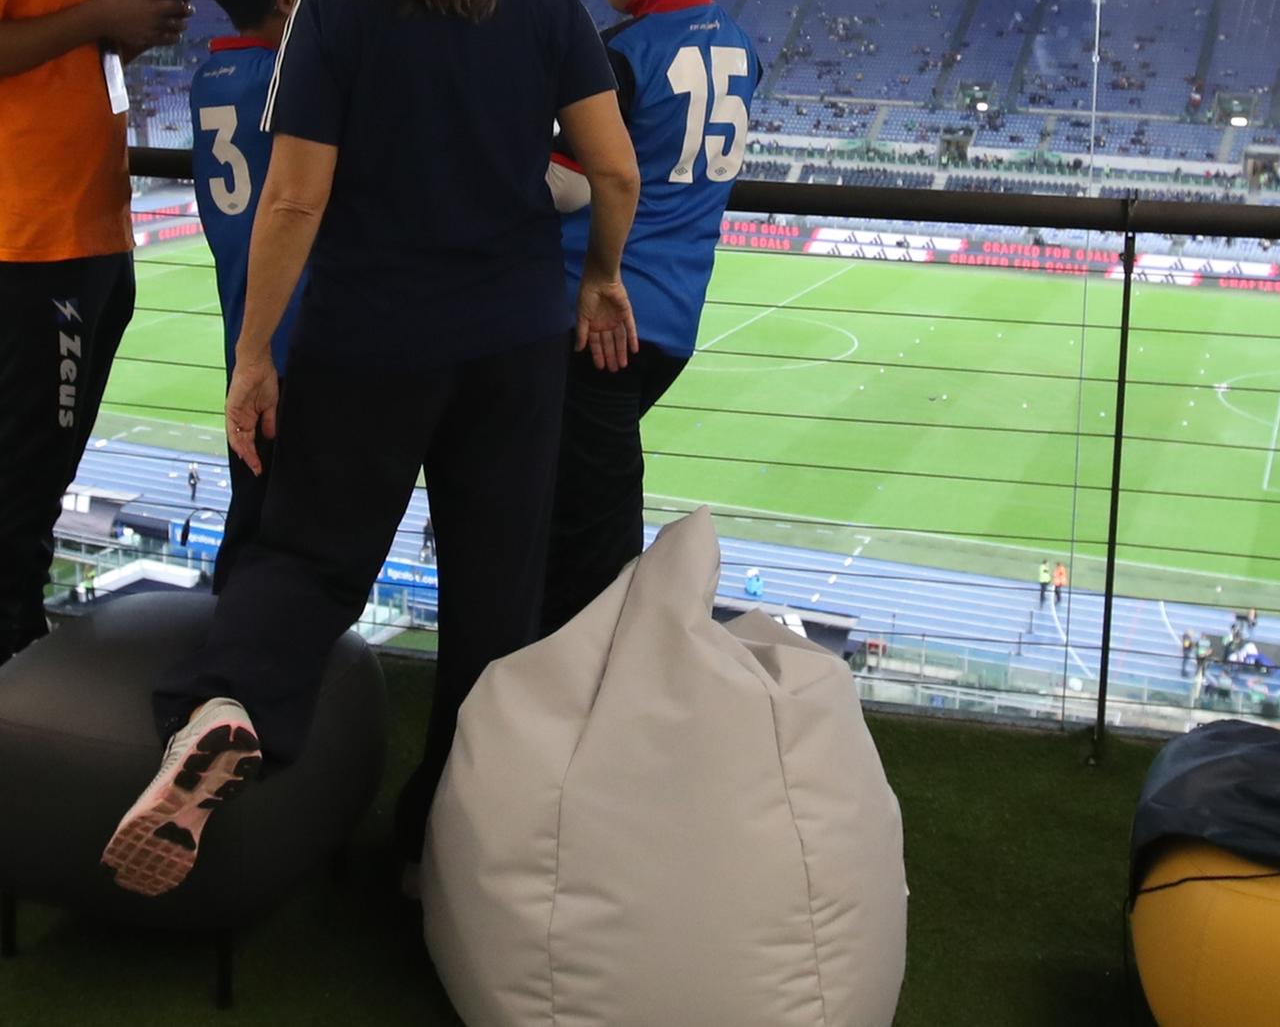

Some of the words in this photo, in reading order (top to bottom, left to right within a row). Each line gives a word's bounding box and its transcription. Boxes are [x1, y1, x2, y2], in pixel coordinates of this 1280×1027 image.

[666, 45, 749, 184] 15
[199, 105, 252, 216] 3
[723, 235, 748, 246] FOR
[750, 237, 791, 250] GOALS
[734, 222, 756, 233] FOR
[761, 223, 800, 236] GOALS
[983, 241, 1041, 258] CRAFTED
[1045, 246, 1071, 259] FOR
[58, 331, 82, 428] Zeus
